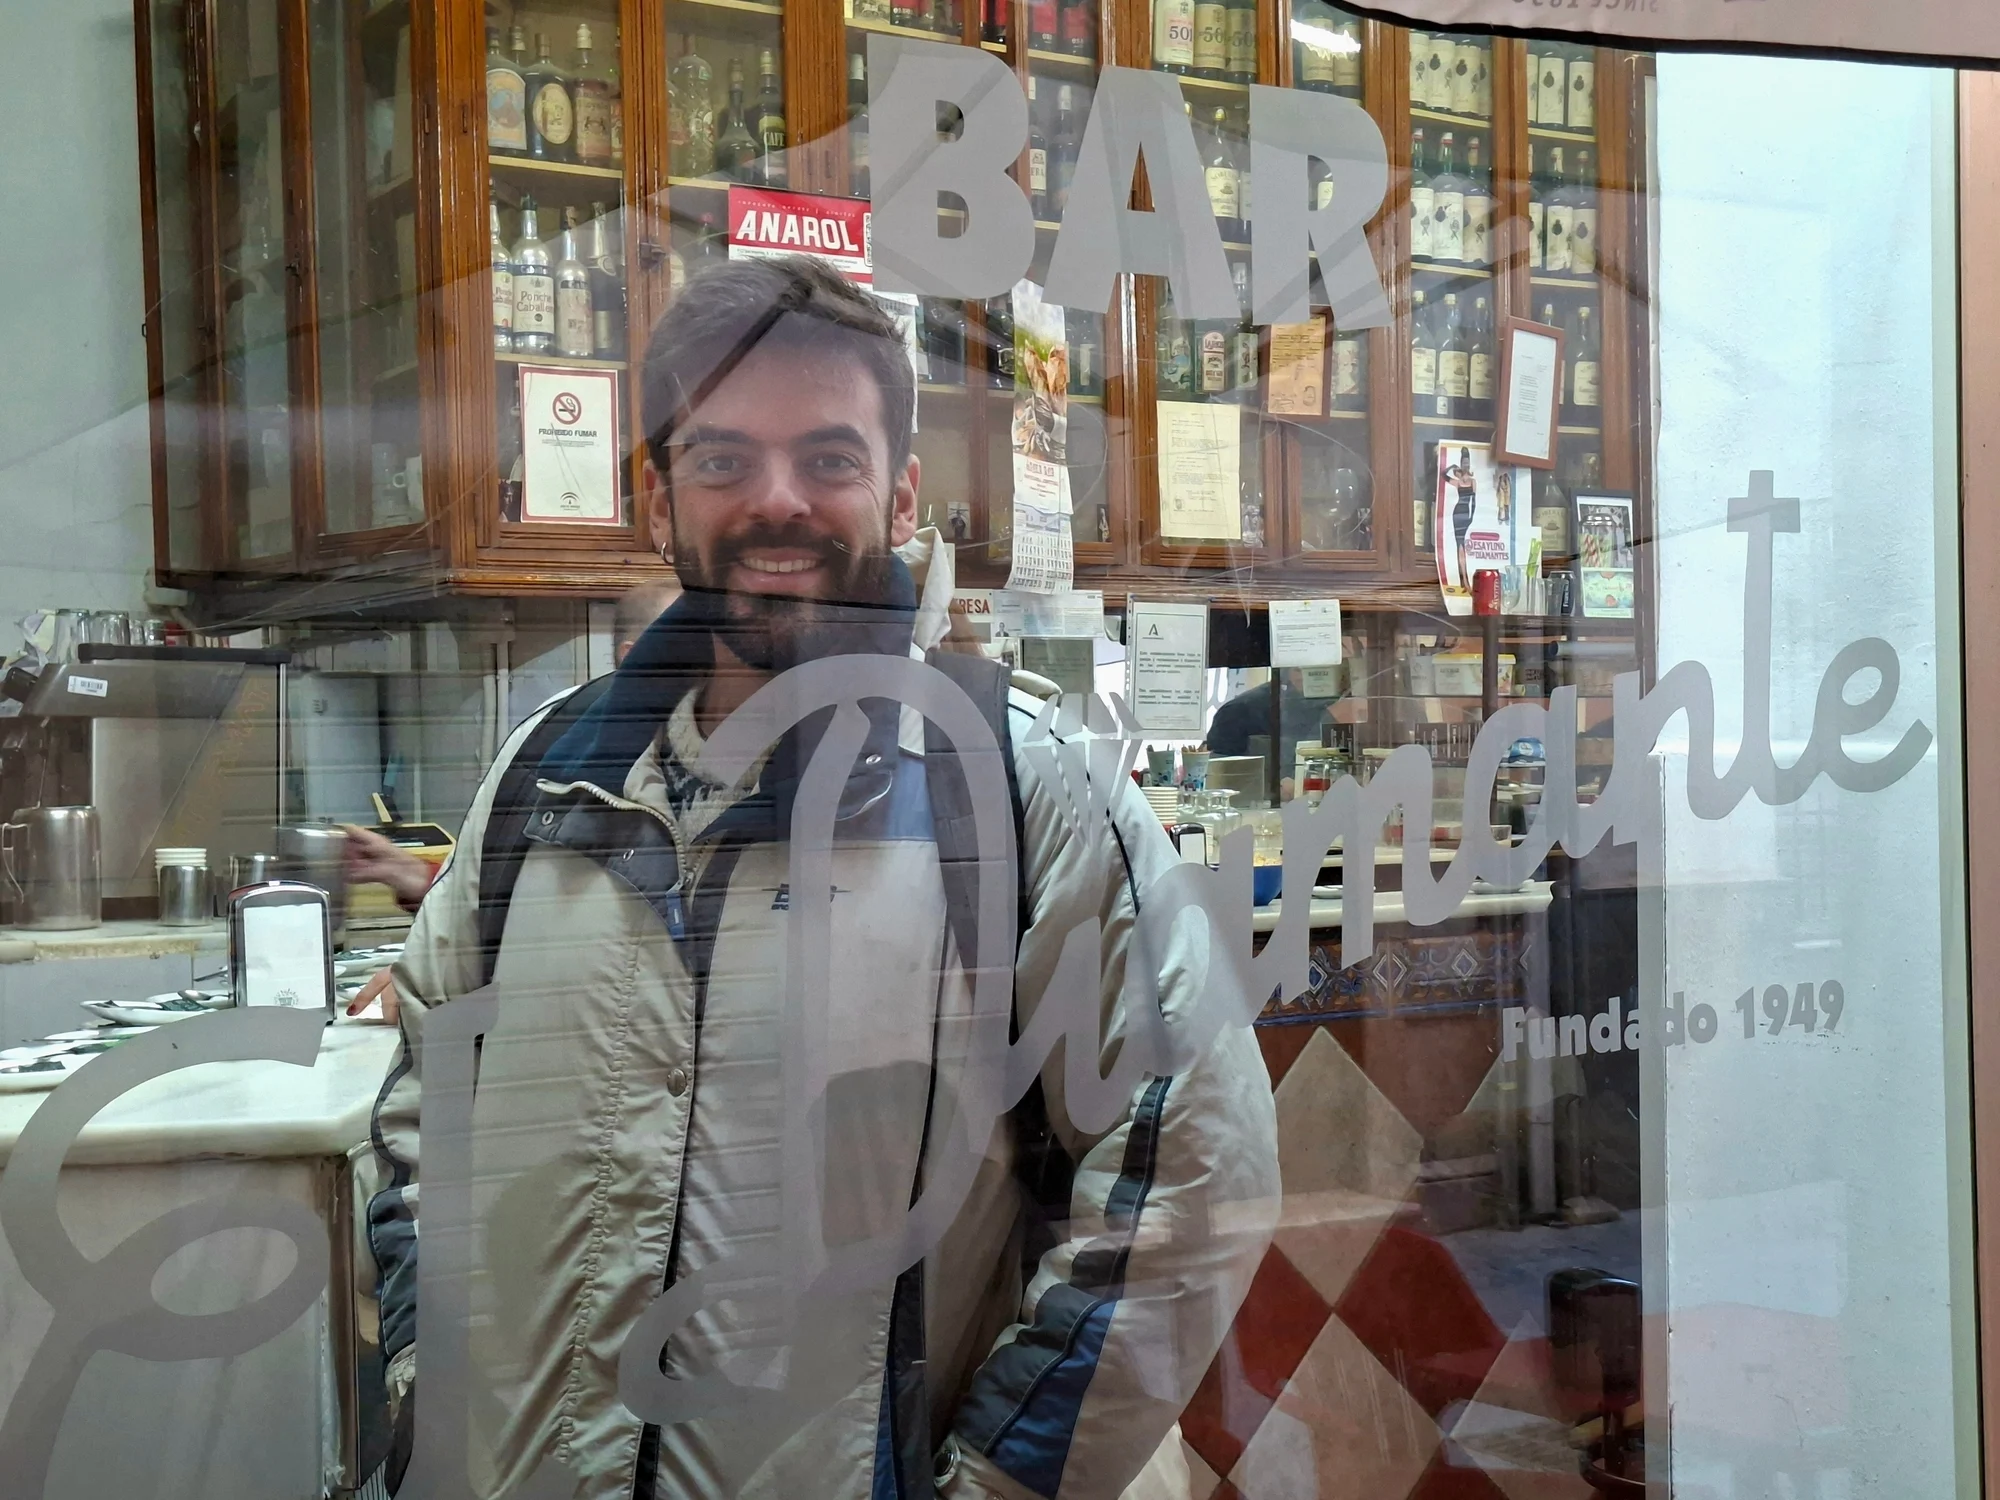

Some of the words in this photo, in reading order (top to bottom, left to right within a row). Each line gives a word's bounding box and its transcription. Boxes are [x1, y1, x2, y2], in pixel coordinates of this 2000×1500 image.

[867, 33, 1393, 329] BAR
[735, 210, 859, 252] ANAROL
[520, 290, 553, 303] Ponche
[538, 428, 573, 436] PROHIBIDO
[1475, 550, 1509, 561] DIAMANTES
[957, 598, 991, 614] RESA
[617, 470, 1933, 1424] Diamante
[1502, 991, 1718, 1063] Fundado
[1735, 979, 1845, 1039] 1949
